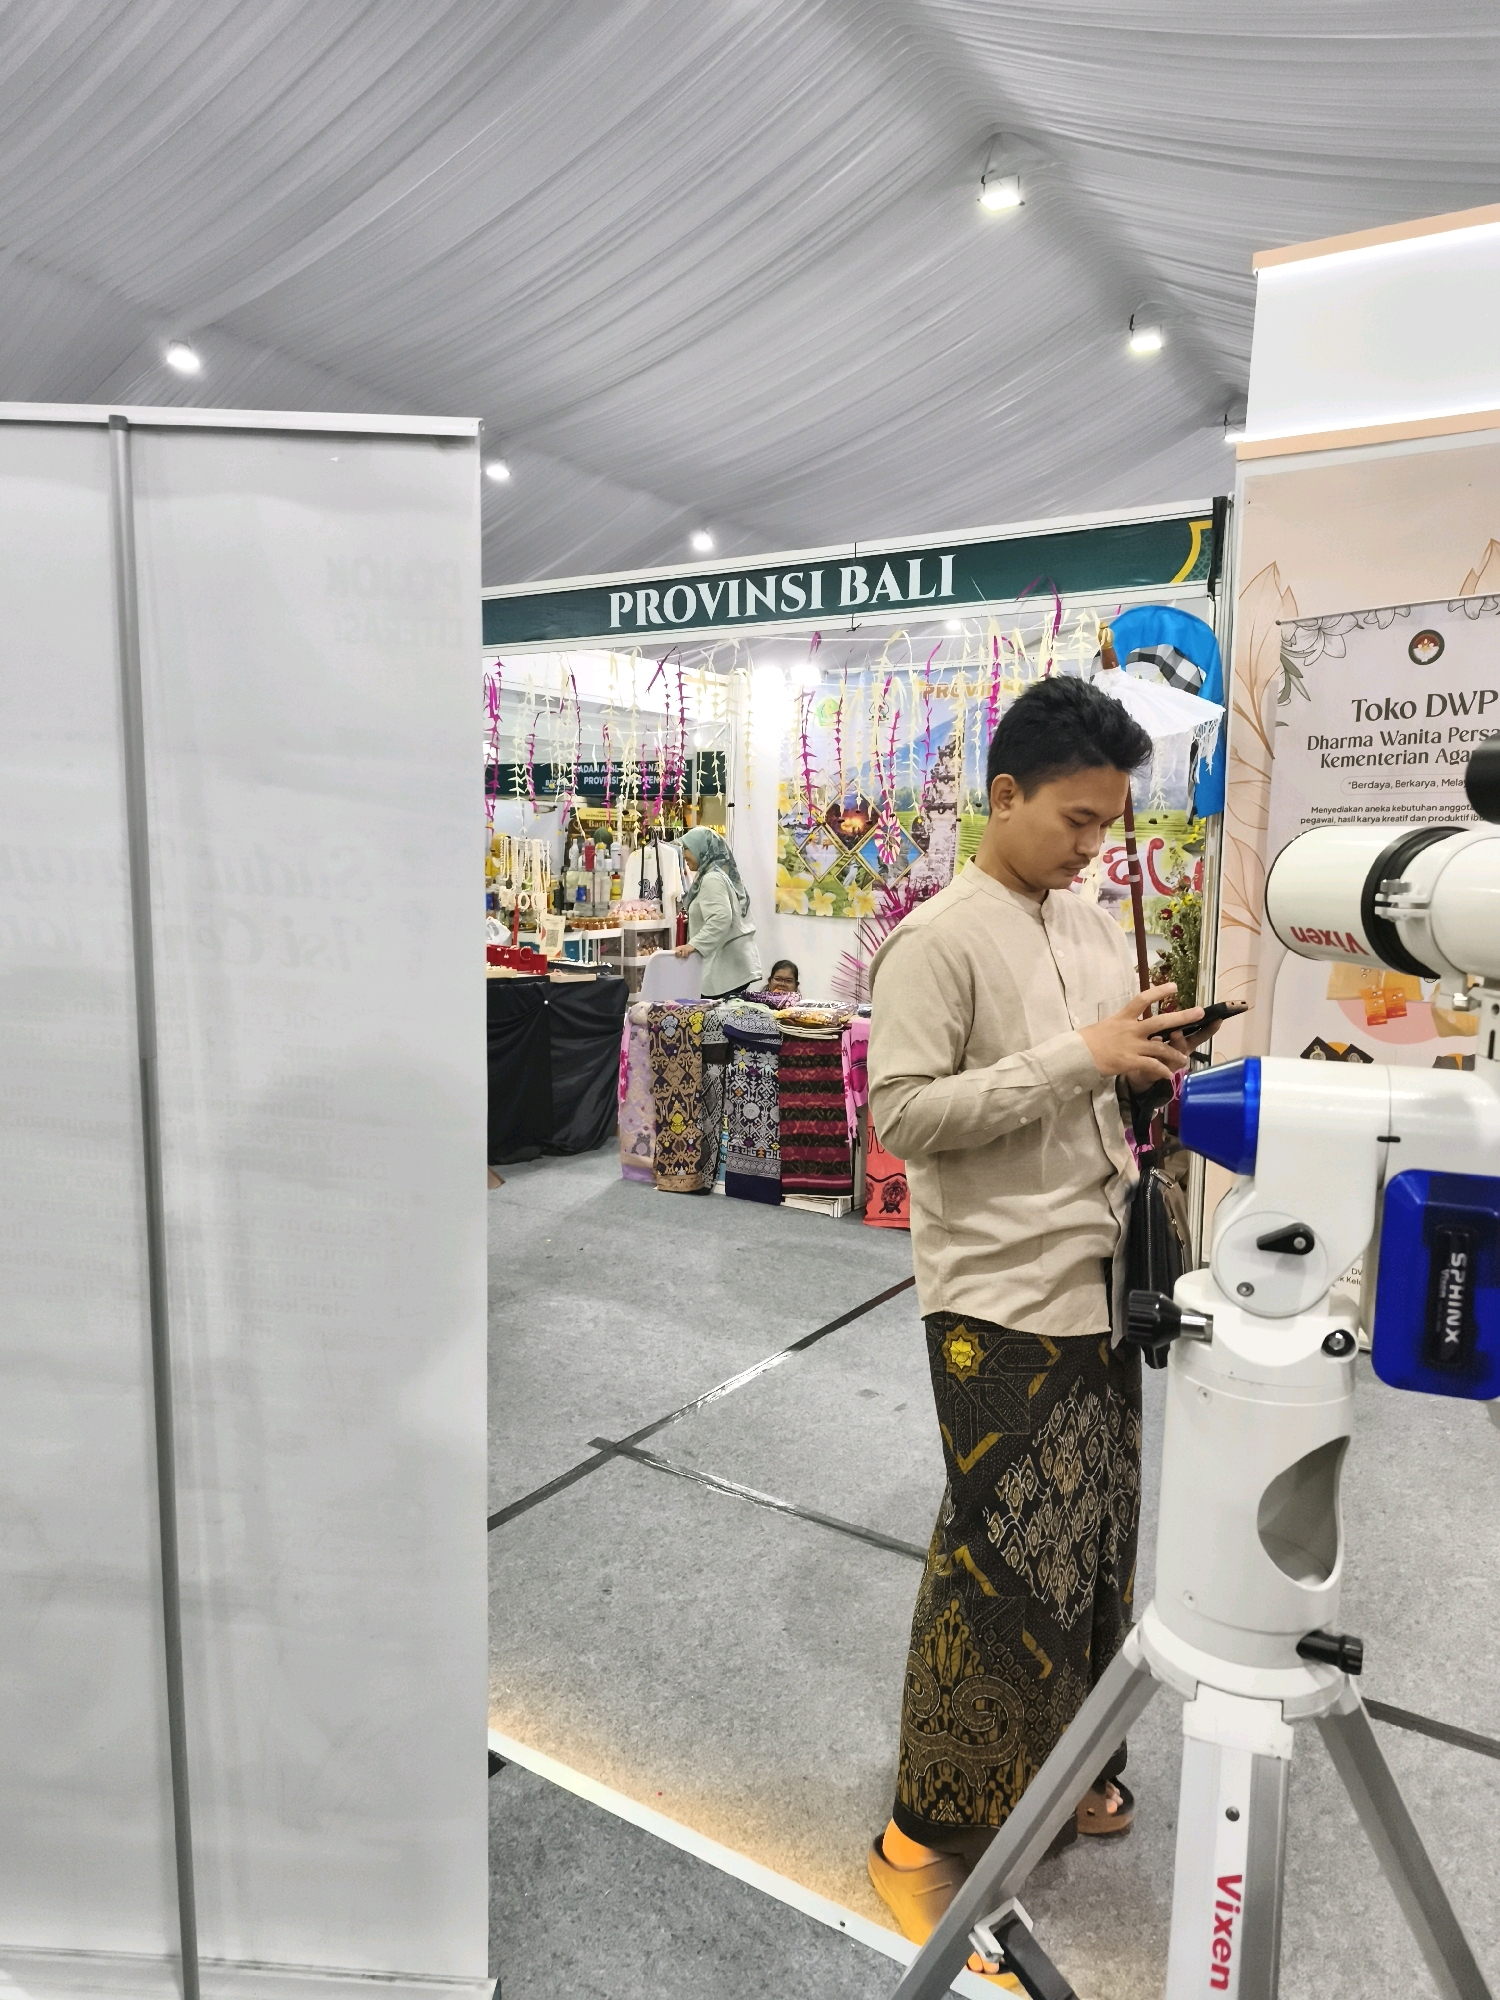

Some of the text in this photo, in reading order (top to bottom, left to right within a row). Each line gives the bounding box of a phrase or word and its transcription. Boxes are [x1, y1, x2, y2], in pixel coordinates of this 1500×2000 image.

[608, 554, 956, 629] PROVINSI BALI
[1351, 689, 1499, 723] Toko DWP
[1307, 732, 1373, 751] Dharma
[1380, 728, 1442, 746] Wanita
[1320, 747, 1471, 769] Kementerian Aga
[1395, 779, 1439, 789] Berkarya,
[1300, 816, 1336, 825] pegawai,
[1337, 815, 1356, 823] hasil
[1356, 815, 1381, 824] karya
[1382, 814, 1408, 823] kreatif
[1410, 814, 1427, 822] dan
[1428, 813, 1469, 824] produktif
[1311, 805, 1363, 815] Menyediakan
[1392, 804, 1437, 812] kebutuhan
[1290, 925, 1371, 956] Vixen
[1444, 1252, 1468, 1344] SPHINX
[1209, 1873, 1243, 1990] Vixen
